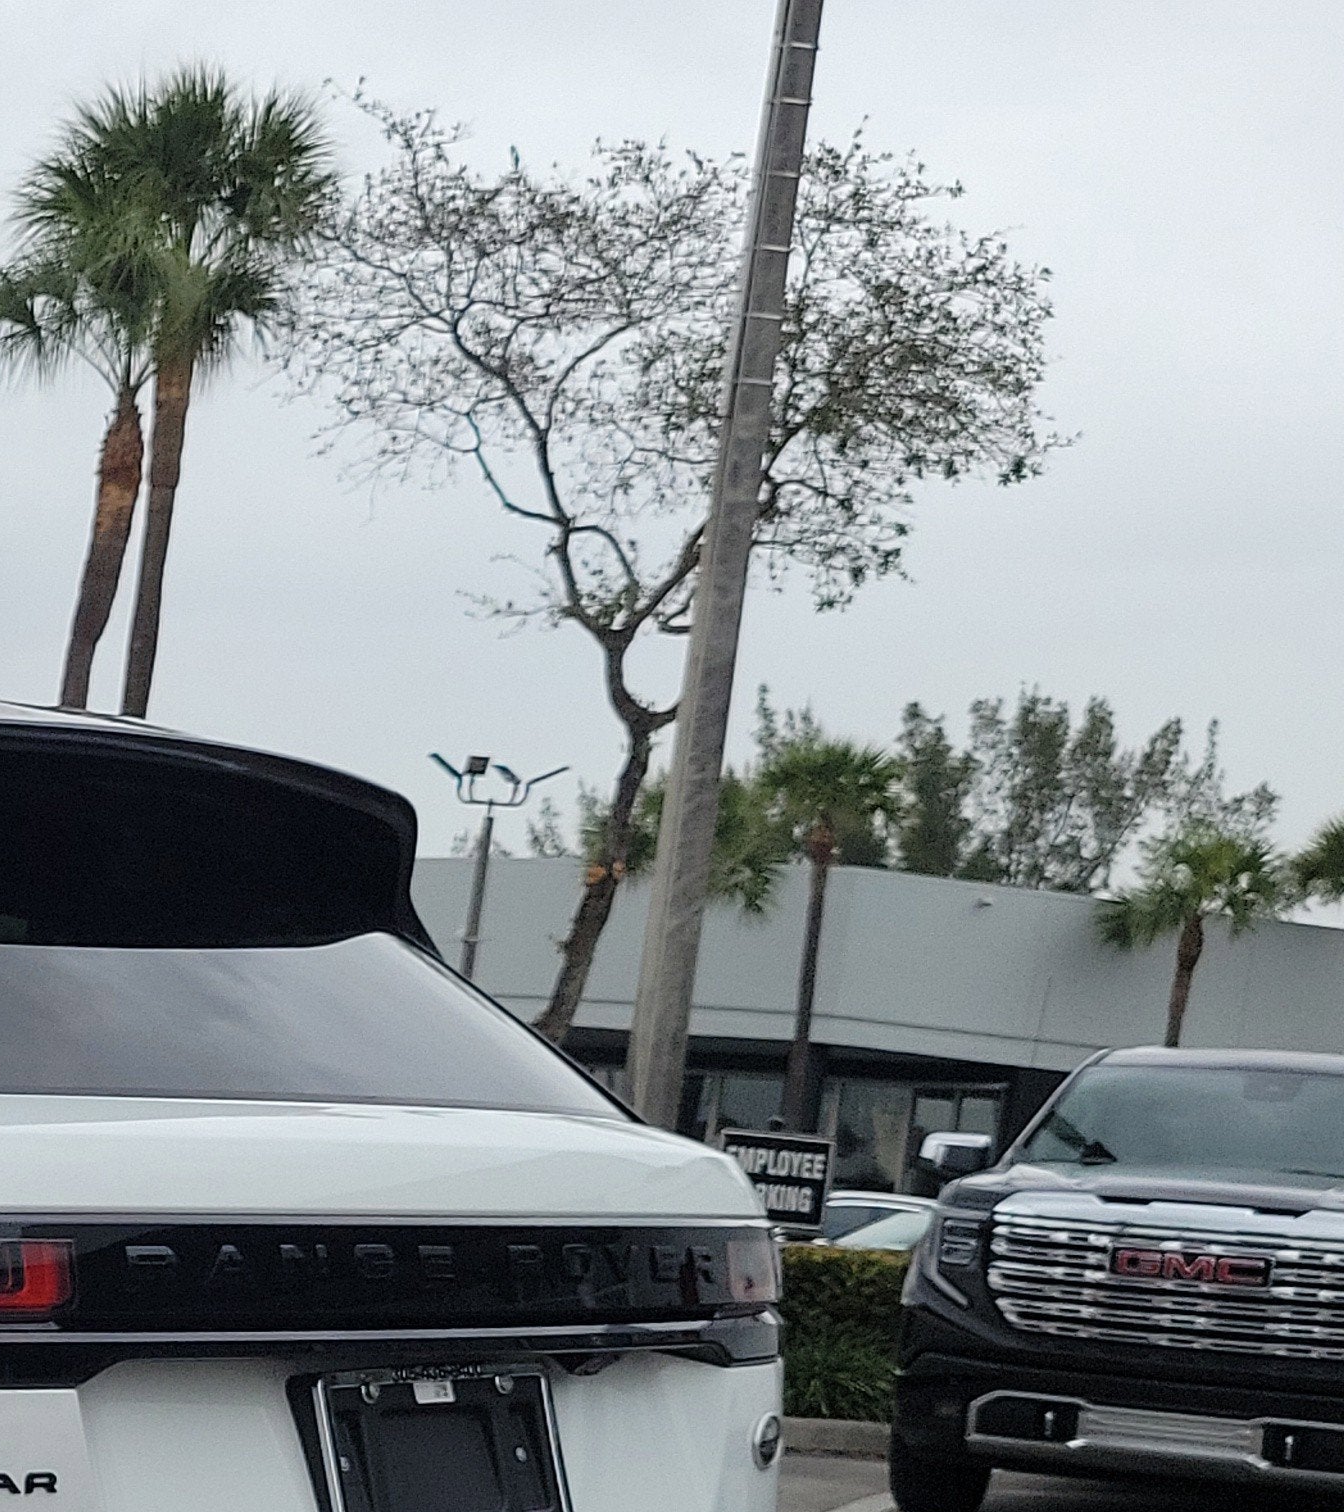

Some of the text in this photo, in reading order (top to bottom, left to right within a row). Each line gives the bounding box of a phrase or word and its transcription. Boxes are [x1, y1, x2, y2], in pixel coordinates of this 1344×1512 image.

[125, 1244, 715, 1285] RANGE ROVER
[1115, 1250, 1265, 1287] GMC
